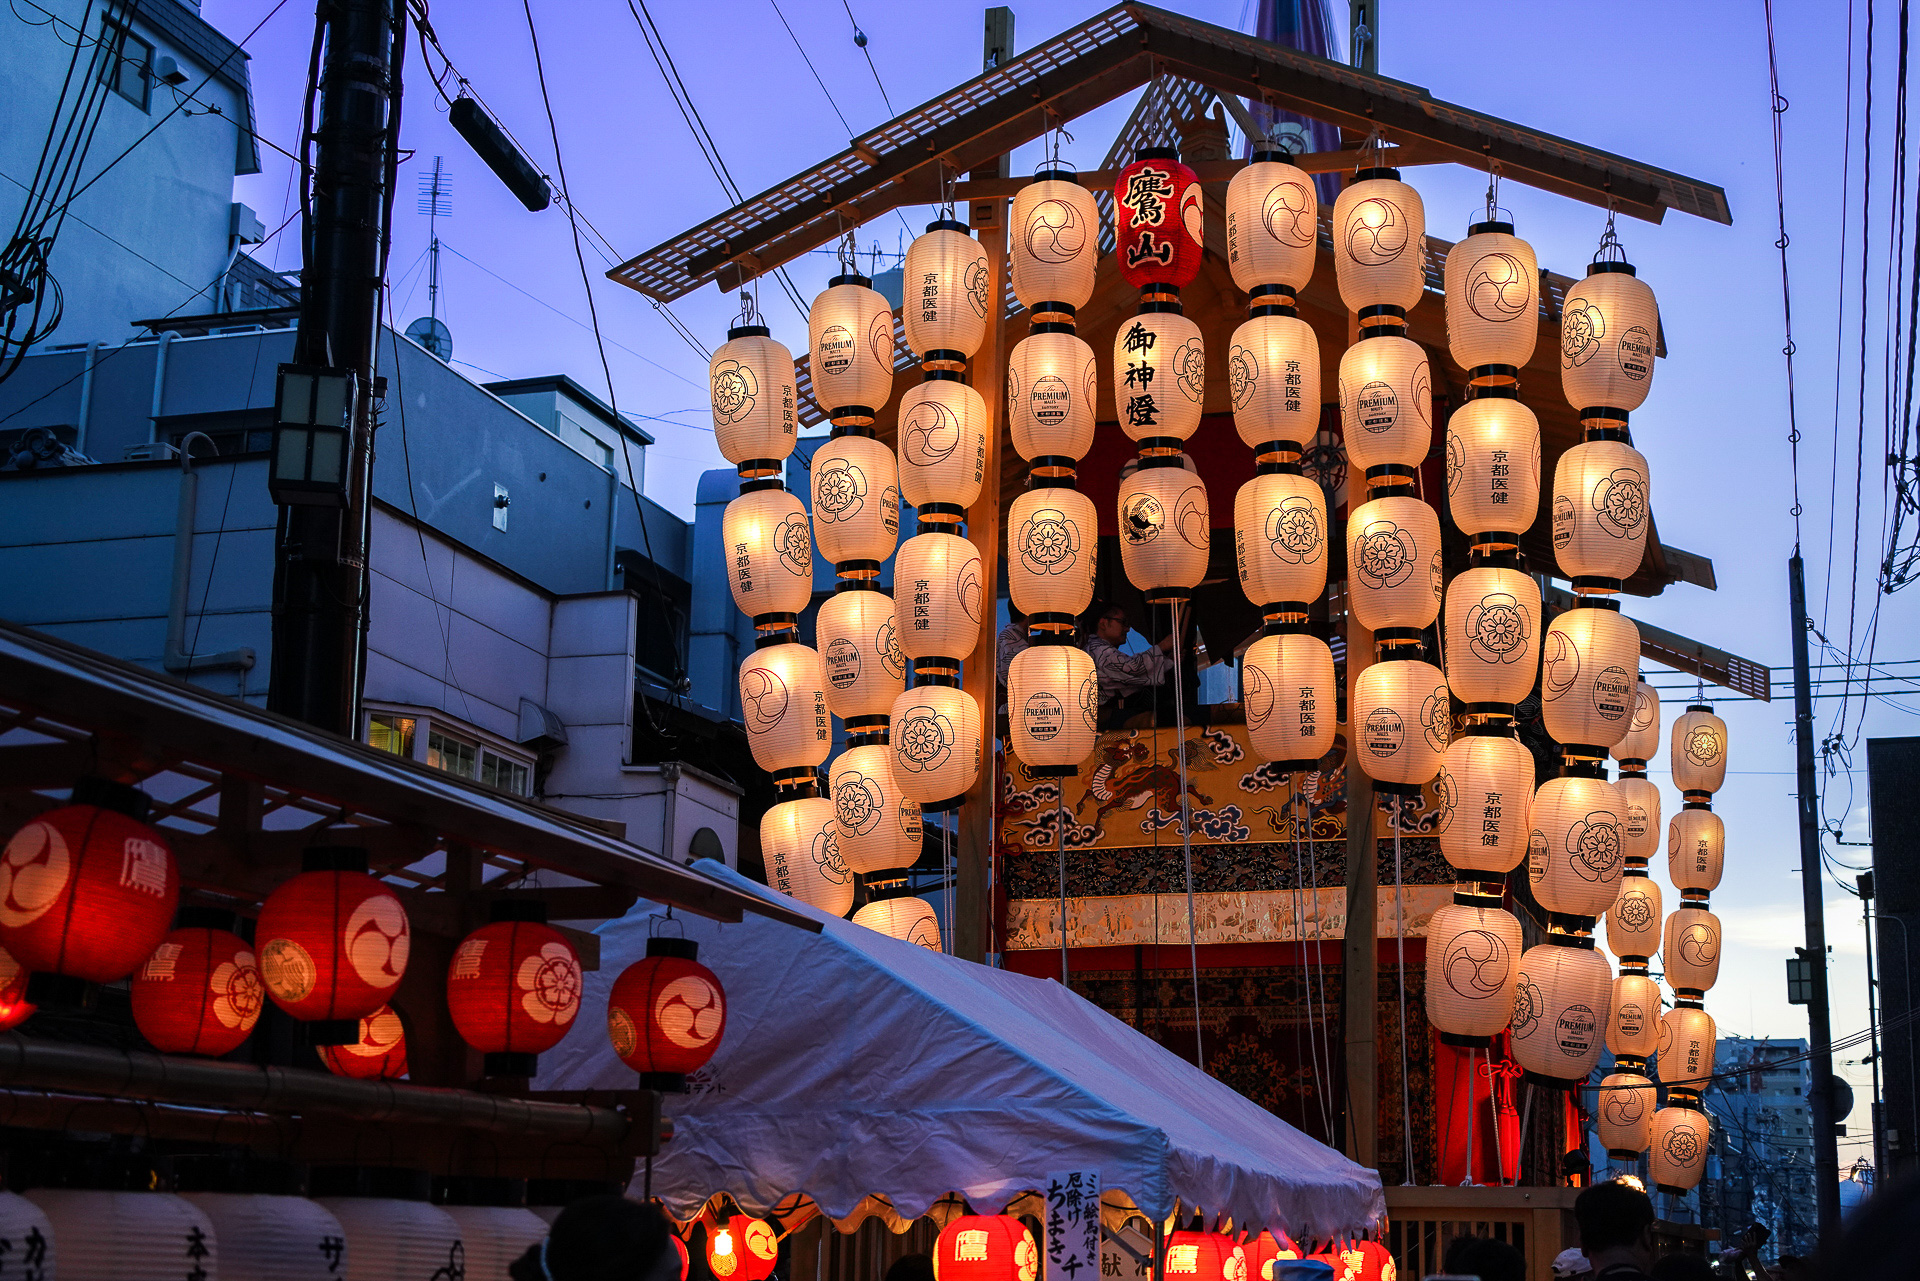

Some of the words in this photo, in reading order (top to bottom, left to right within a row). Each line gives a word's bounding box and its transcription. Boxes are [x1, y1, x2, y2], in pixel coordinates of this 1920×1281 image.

[1122, 166, 1174, 269] 鷹山
[922, 272, 939, 322] 京都医健
[1122, 321, 1161, 426] 御神燈
[1621, 341, 1651, 356] PREMIUM
[781, 384, 794, 434] 京都医健
[1033, 391, 1068, 400] PREMIUM
[1285, 360, 1301, 412] 京都医健
[1359, 396, 1396, 409] PREMIUM
[1491, 449, 1509, 504] 京都医健
[735, 542, 755, 593] 京都医健
[914, 579, 930, 631] 京都医健
[827, 652, 858, 665] PREMIUM
[1026, 707, 1060, 716] PREMIUM
[1299, 686, 1316, 737] 京都医健
[1597, 681, 1629, 694] PREMIUM
[813, 690, 828, 741] 京都医健
[1366, 723, 1401, 732] PREMIUM
[1481, 792, 1502, 846] 京都医健
[1559, 1018, 1594, 1032] PREMIUM
[1047, 1179, 1066, 1266] ちまき
[1065, 1172, 1084, 1230] 厄除け
[1083, 1173, 1100, 1267] ミニ絵馬付き
[319, 1236, 344, 1280] ザ
